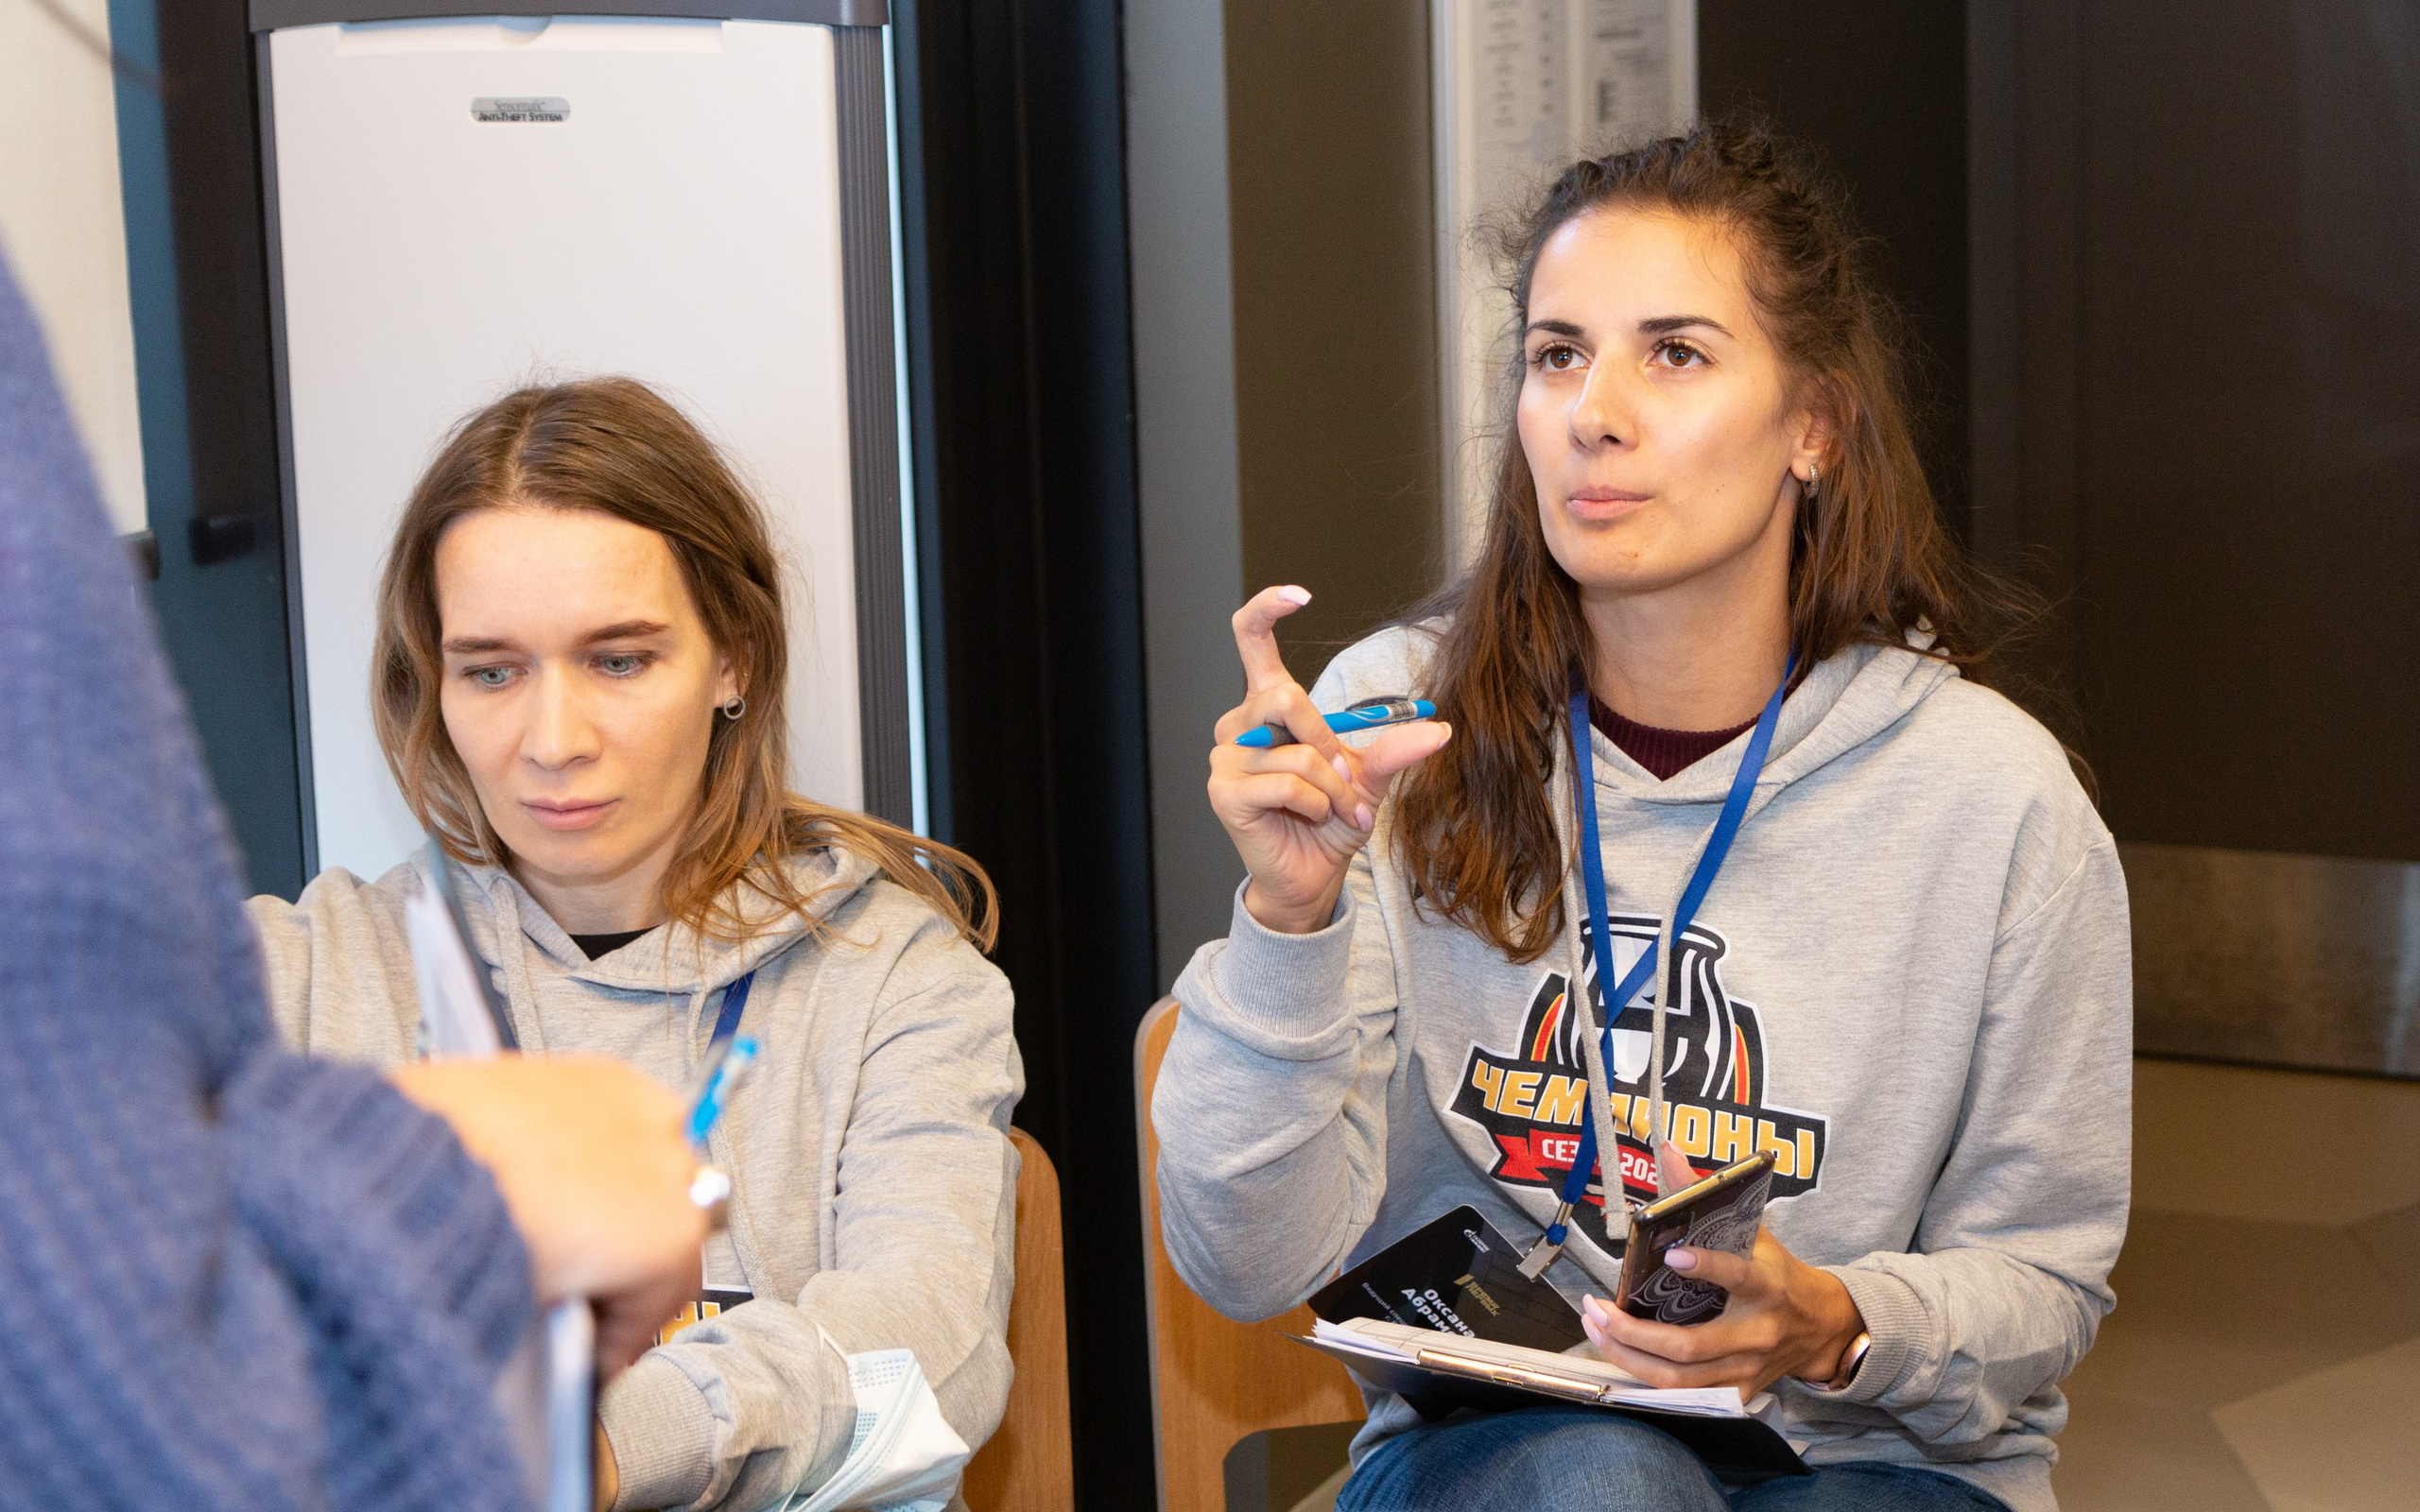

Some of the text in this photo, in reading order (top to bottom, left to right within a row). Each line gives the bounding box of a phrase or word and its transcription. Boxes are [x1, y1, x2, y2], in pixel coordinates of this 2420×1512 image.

[529, 112, 563, 122] SYSTEM
[1620, 1152, 1659, 1185] 202
[1424, 1288, 1476, 1337] Оксана
